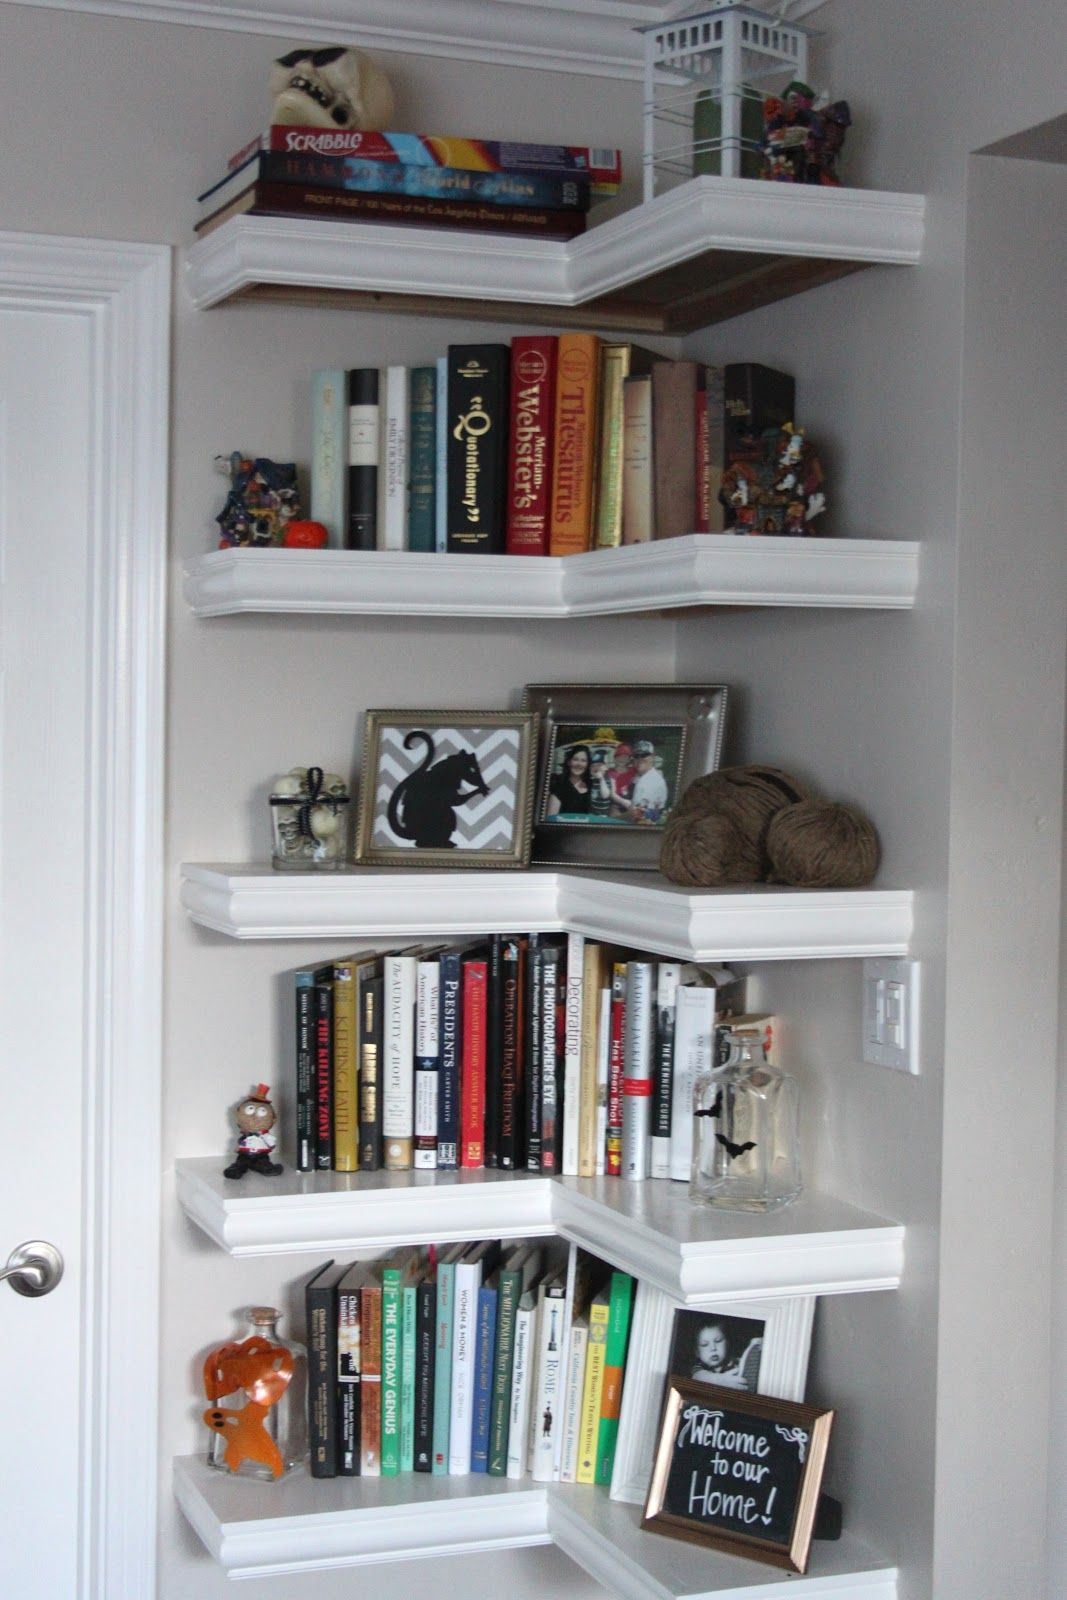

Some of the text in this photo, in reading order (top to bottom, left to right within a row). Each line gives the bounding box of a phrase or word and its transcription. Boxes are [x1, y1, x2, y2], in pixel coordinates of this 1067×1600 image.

[285, 131, 362, 152] SCRABBLE
[514, 384, 541, 508] Webster's
[534, 436, 546, 489] Merriam-
[556, 387, 585, 523] Thesaurus
[392, 962, 401, 978] The
[543, 964, 556, 984] THE
[392, 980, 401, 1040] AUDACITY
[430, 986, 438, 1010] What
[472, 986, 480, 1001] THE
[301, 1016, 308, 1024] OF
[417, 974, 428, 1055] American History
[444, 980, 459, 1067] PRESIDENTS
[543, 987, 556, 1082] PHOTOGRAPHER'S
[565, 976, 583, 1055] Decorating
[631, 968, 645, 1067] READING JACKIE
[336, 1016, 349, 1084] KEEPING
[471, 1034, 480, 1068] HISTORY
[501, 979, 516, 1137] OPERATION IRAQI FREEDOM
[696, 1034, 704, 1047] AN
[319, 1018, 329, 1140] THE KILLING ZONE
[392, 1057, 401, 1089] HOPE
[610, 1039, 620, 1122] Has Been Shot
[660, 1043, 671, 1130] THE KENNEDY CURSE
[336, 1090, 349, 1133] FAITH
[543, 1085, 555, 1105] EYE
[349, 1296, 358, 1325] Chicken
[499, 1297, 512, 1351] MILLIONAIRE
[519, 1320, 527, 1330] The
[458, 1332, 466, 1361] MONEY
[516, 1332, 526, 1370] Imagineering
[592, 1356, 600, 1373] BEST
[385, 1302, 397, 1434] THE EVERYDAY GENIUS
[496, 1374, 507, 1394] DOOR
[515, 1371, 524, 1385] Way
[545, 1360, 559, 1394] ROME
[690, 1413, 770, 1457] Welcome
[711, 1451, 770, 1483] to our
[688, 1470, 777, 1525] Home!
